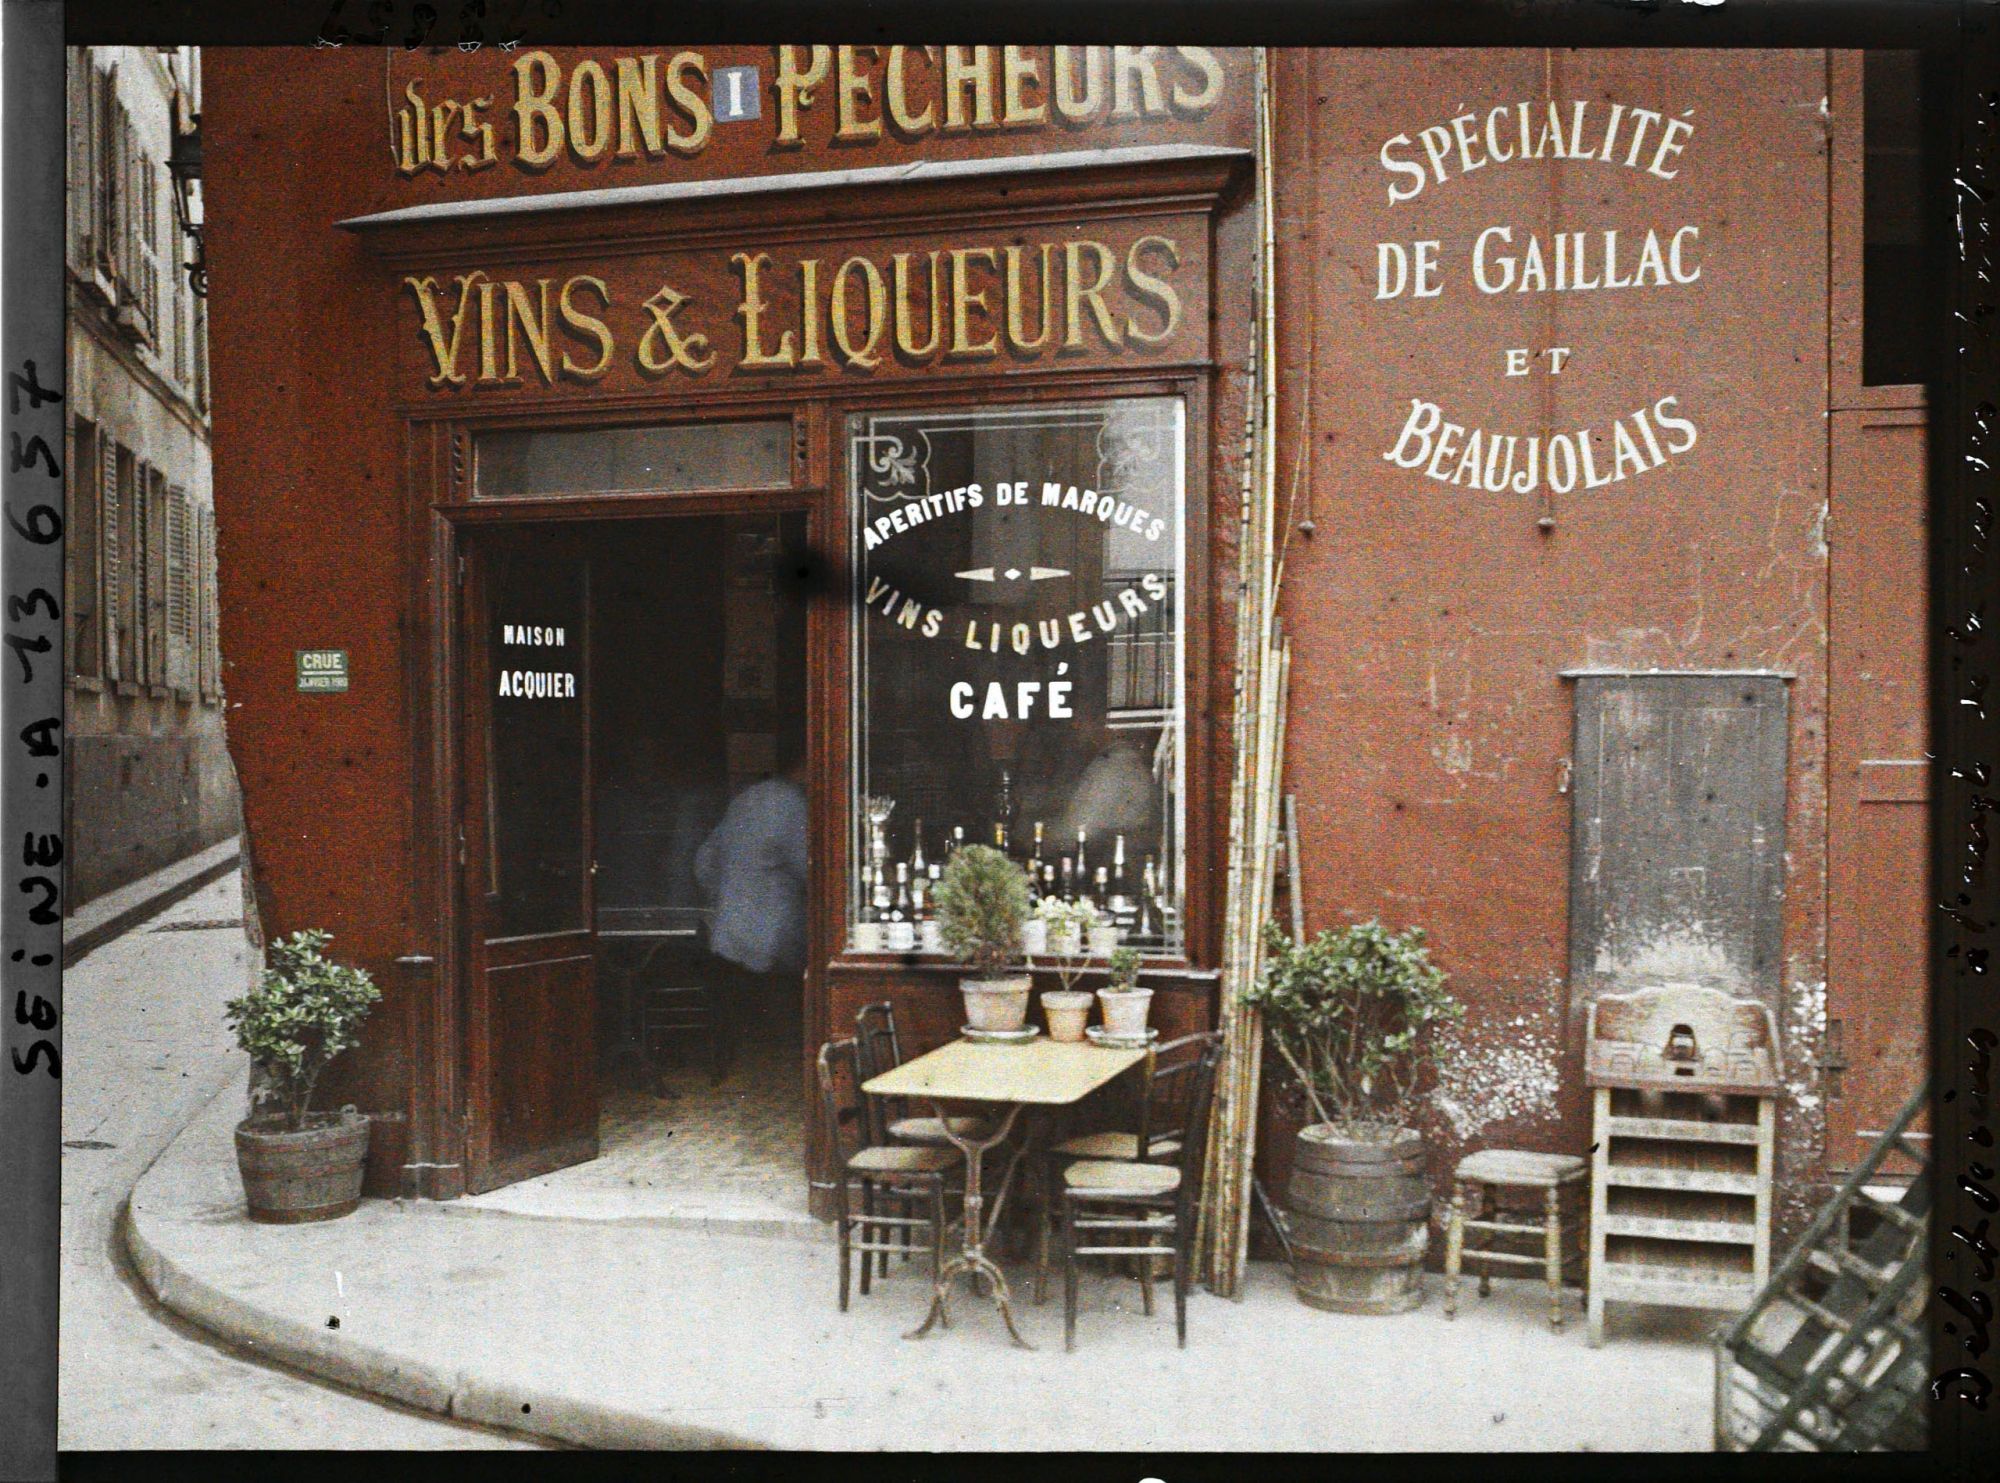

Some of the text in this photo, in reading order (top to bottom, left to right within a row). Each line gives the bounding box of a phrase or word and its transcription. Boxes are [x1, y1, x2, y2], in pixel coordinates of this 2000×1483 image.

[398, 78, 498, 174] des
[512, 51, 713, 166] BONS
[1380, 100, 1695, 207] SPÉCIALITÉ
[1375, 225, 1701, 300] DE GAILLAC
[404, 235, 1183, 384] VINS & LIQUEURS
[1505, 347, 1571, 377] ET
[1382, 395, 1698, 494] BEAUJOLAIS
[862, 481, 1166, 550] APERITIFS DE MARQUES
[503, 624, 565, 647] MAISON
[865, 573, 1168, 655] VINS LIQUEURS
[302, 653, 343, 669] CRUE
[498, 669, 576, 699] ACQUIER
[949, 661, 1073, 720] CAFÉ
